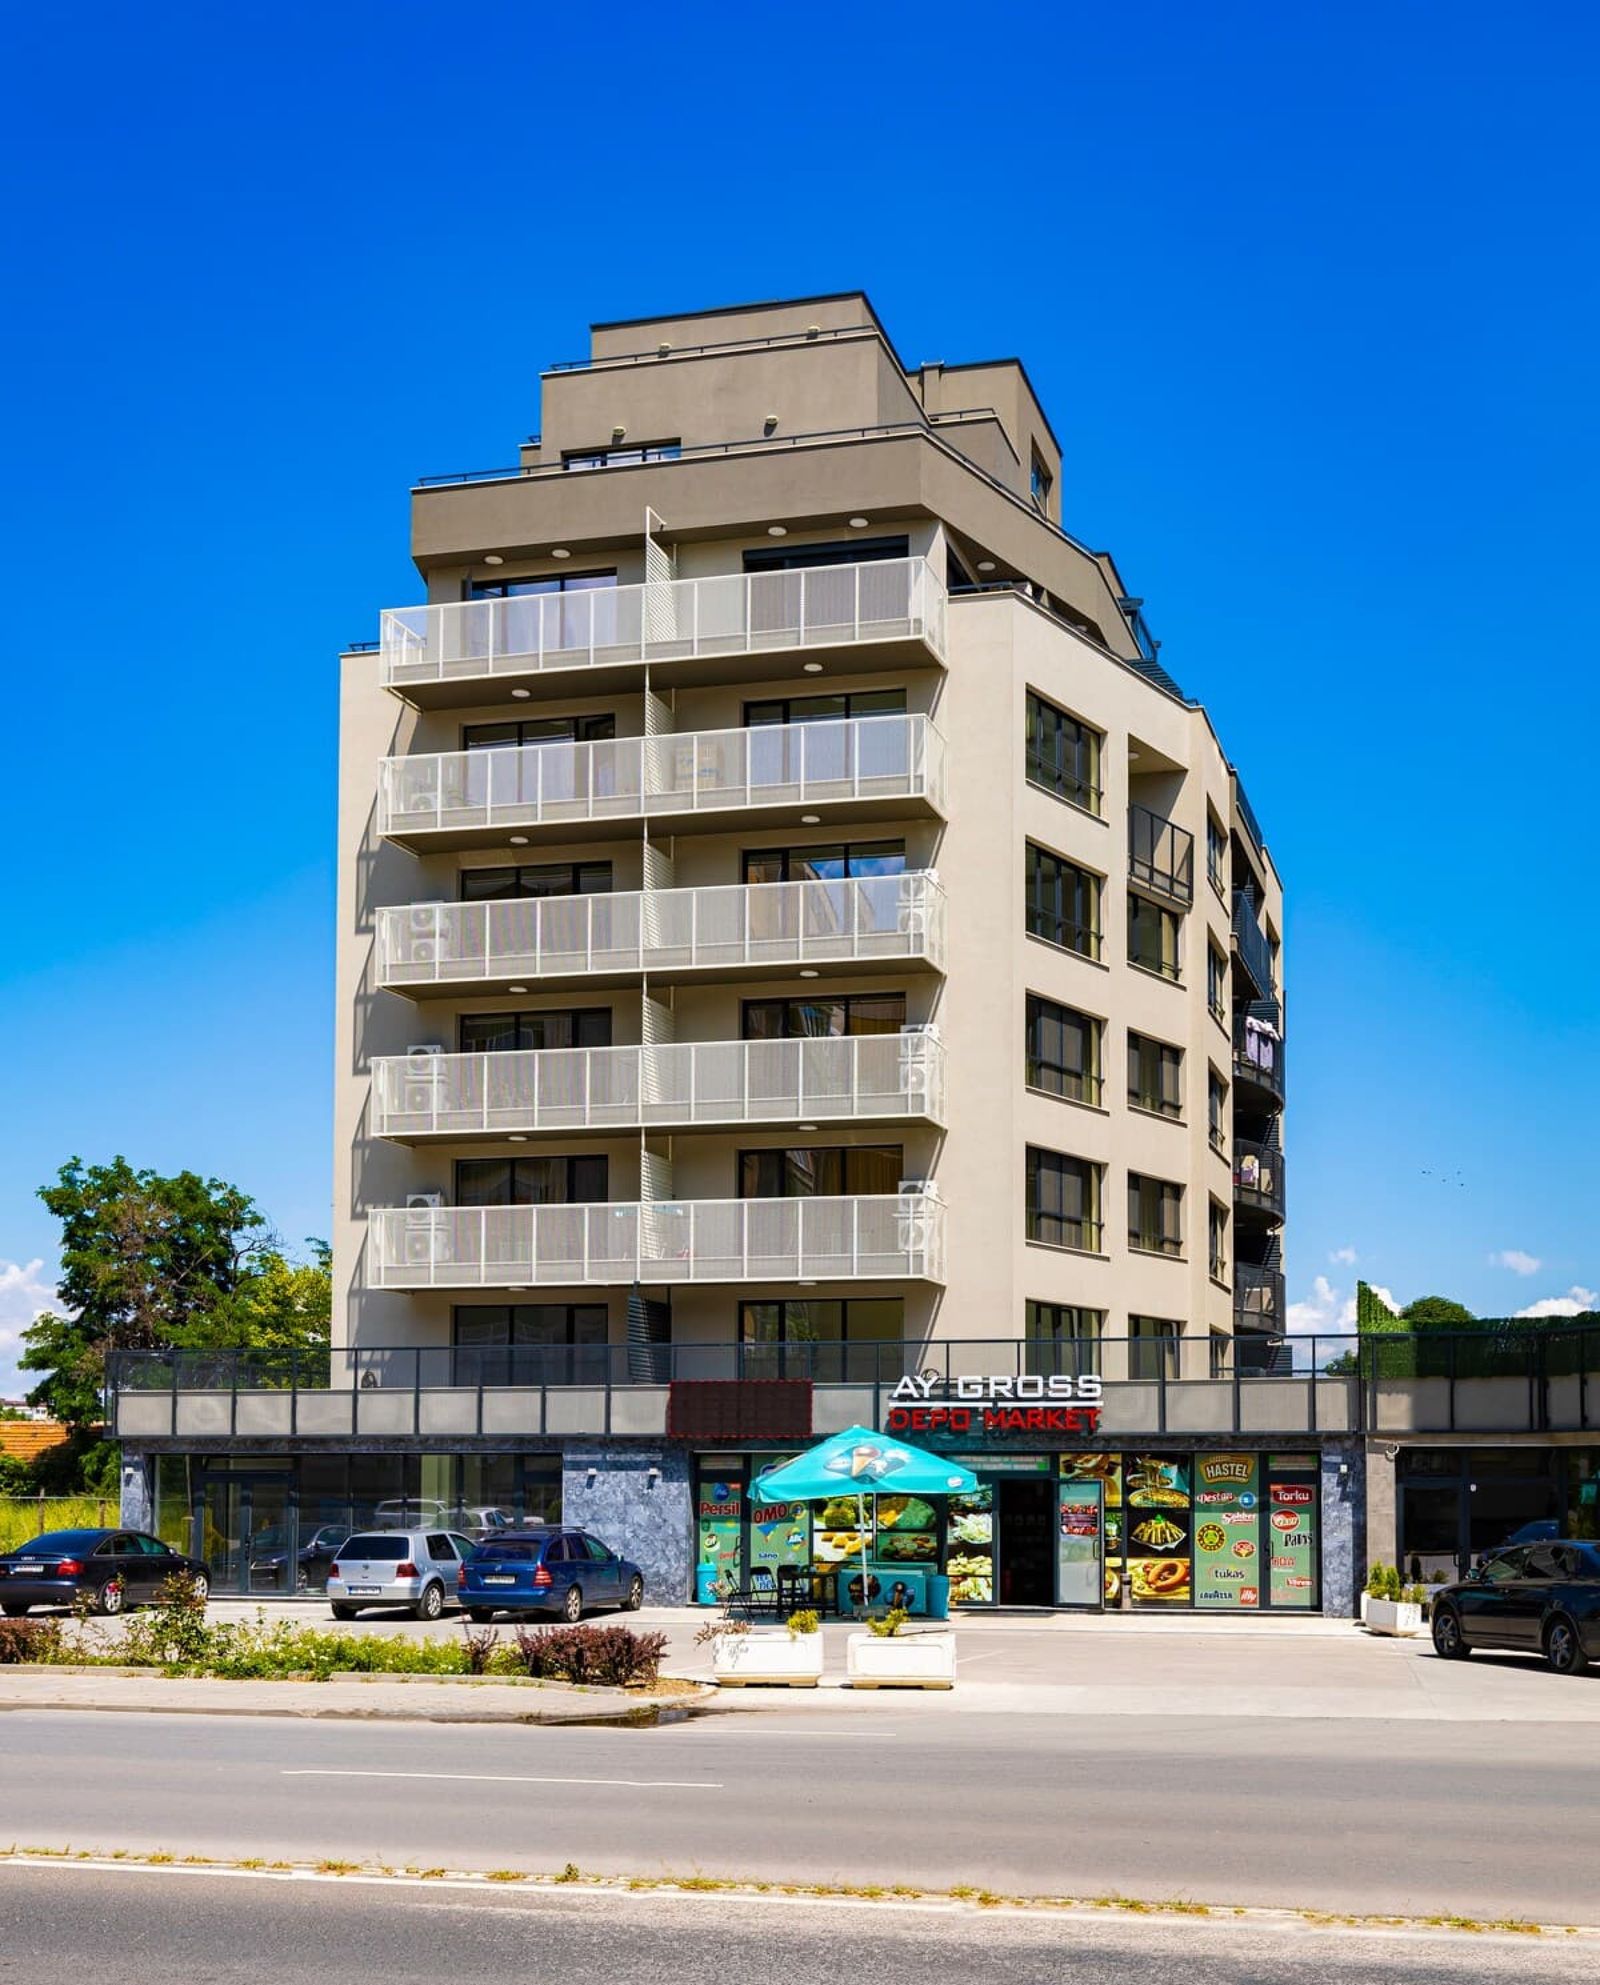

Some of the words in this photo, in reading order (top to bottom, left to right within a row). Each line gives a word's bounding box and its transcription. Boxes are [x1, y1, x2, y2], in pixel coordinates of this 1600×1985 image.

[892, 1375, 940, 1398] AY
[957, 1375, 1102, 1398] GROSS
[889, 1408, 971, 1431] DEPO
[983, 1407, 1102, 1431] MARKET
[1206, 1463, 1249, 1478] HASTEL
[1277, 1490, 1310, 1501] Torku
[700, 1501, 740, 1516] Persil
[753, 1503, 788, 1524] OMO
[758, 1552, 778, 1560] sano
